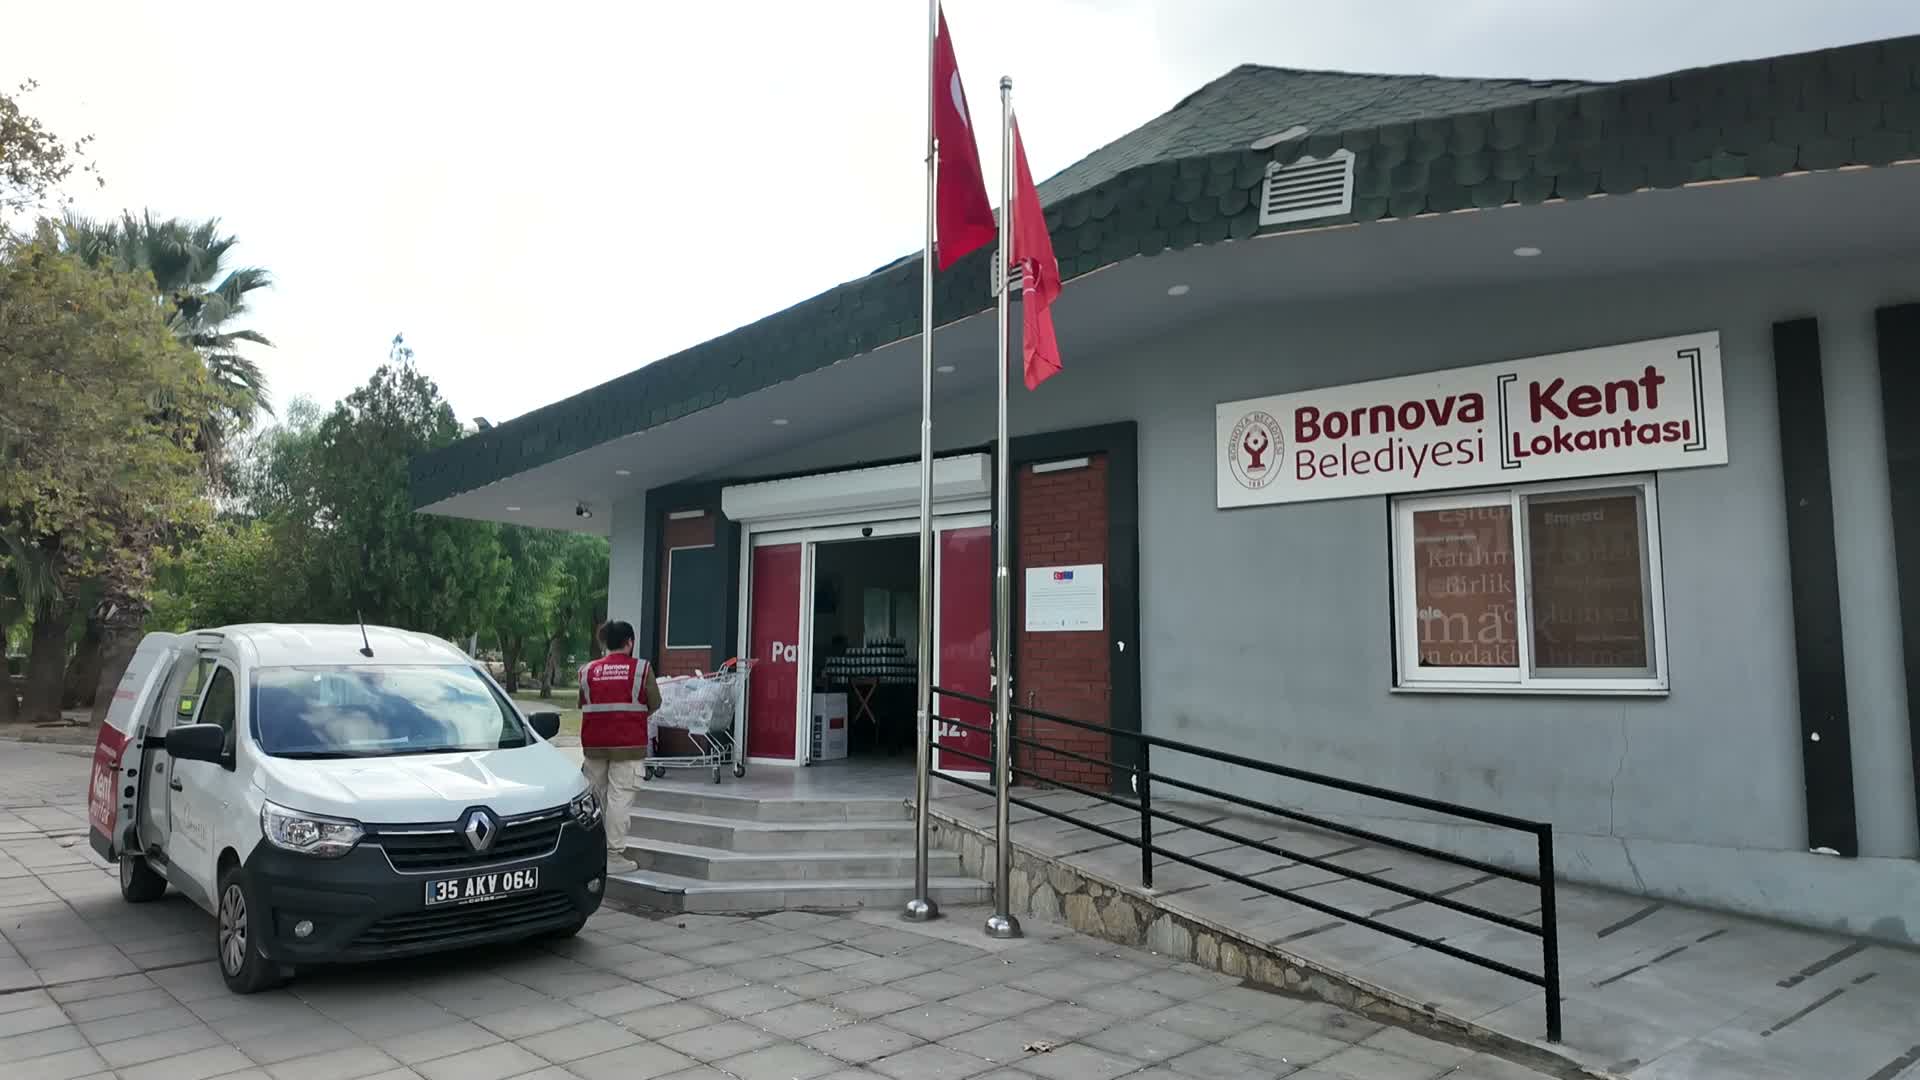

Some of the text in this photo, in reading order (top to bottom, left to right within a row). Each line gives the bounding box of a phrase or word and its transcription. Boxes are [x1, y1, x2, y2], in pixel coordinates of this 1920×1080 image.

[1529, 365, 1666, 423] Kent
[1294, 392, 1485, 443] Bornova
[1513, 418, 1691, 458] Lokantası
[1295, 428, 1485, 481] Belediyesi
[772, 640, 799, 663] Pa
[436, 880, 459, 901] 35
[464, 874, 498, 897] AKV
[502, 869, 535, 891] 064
